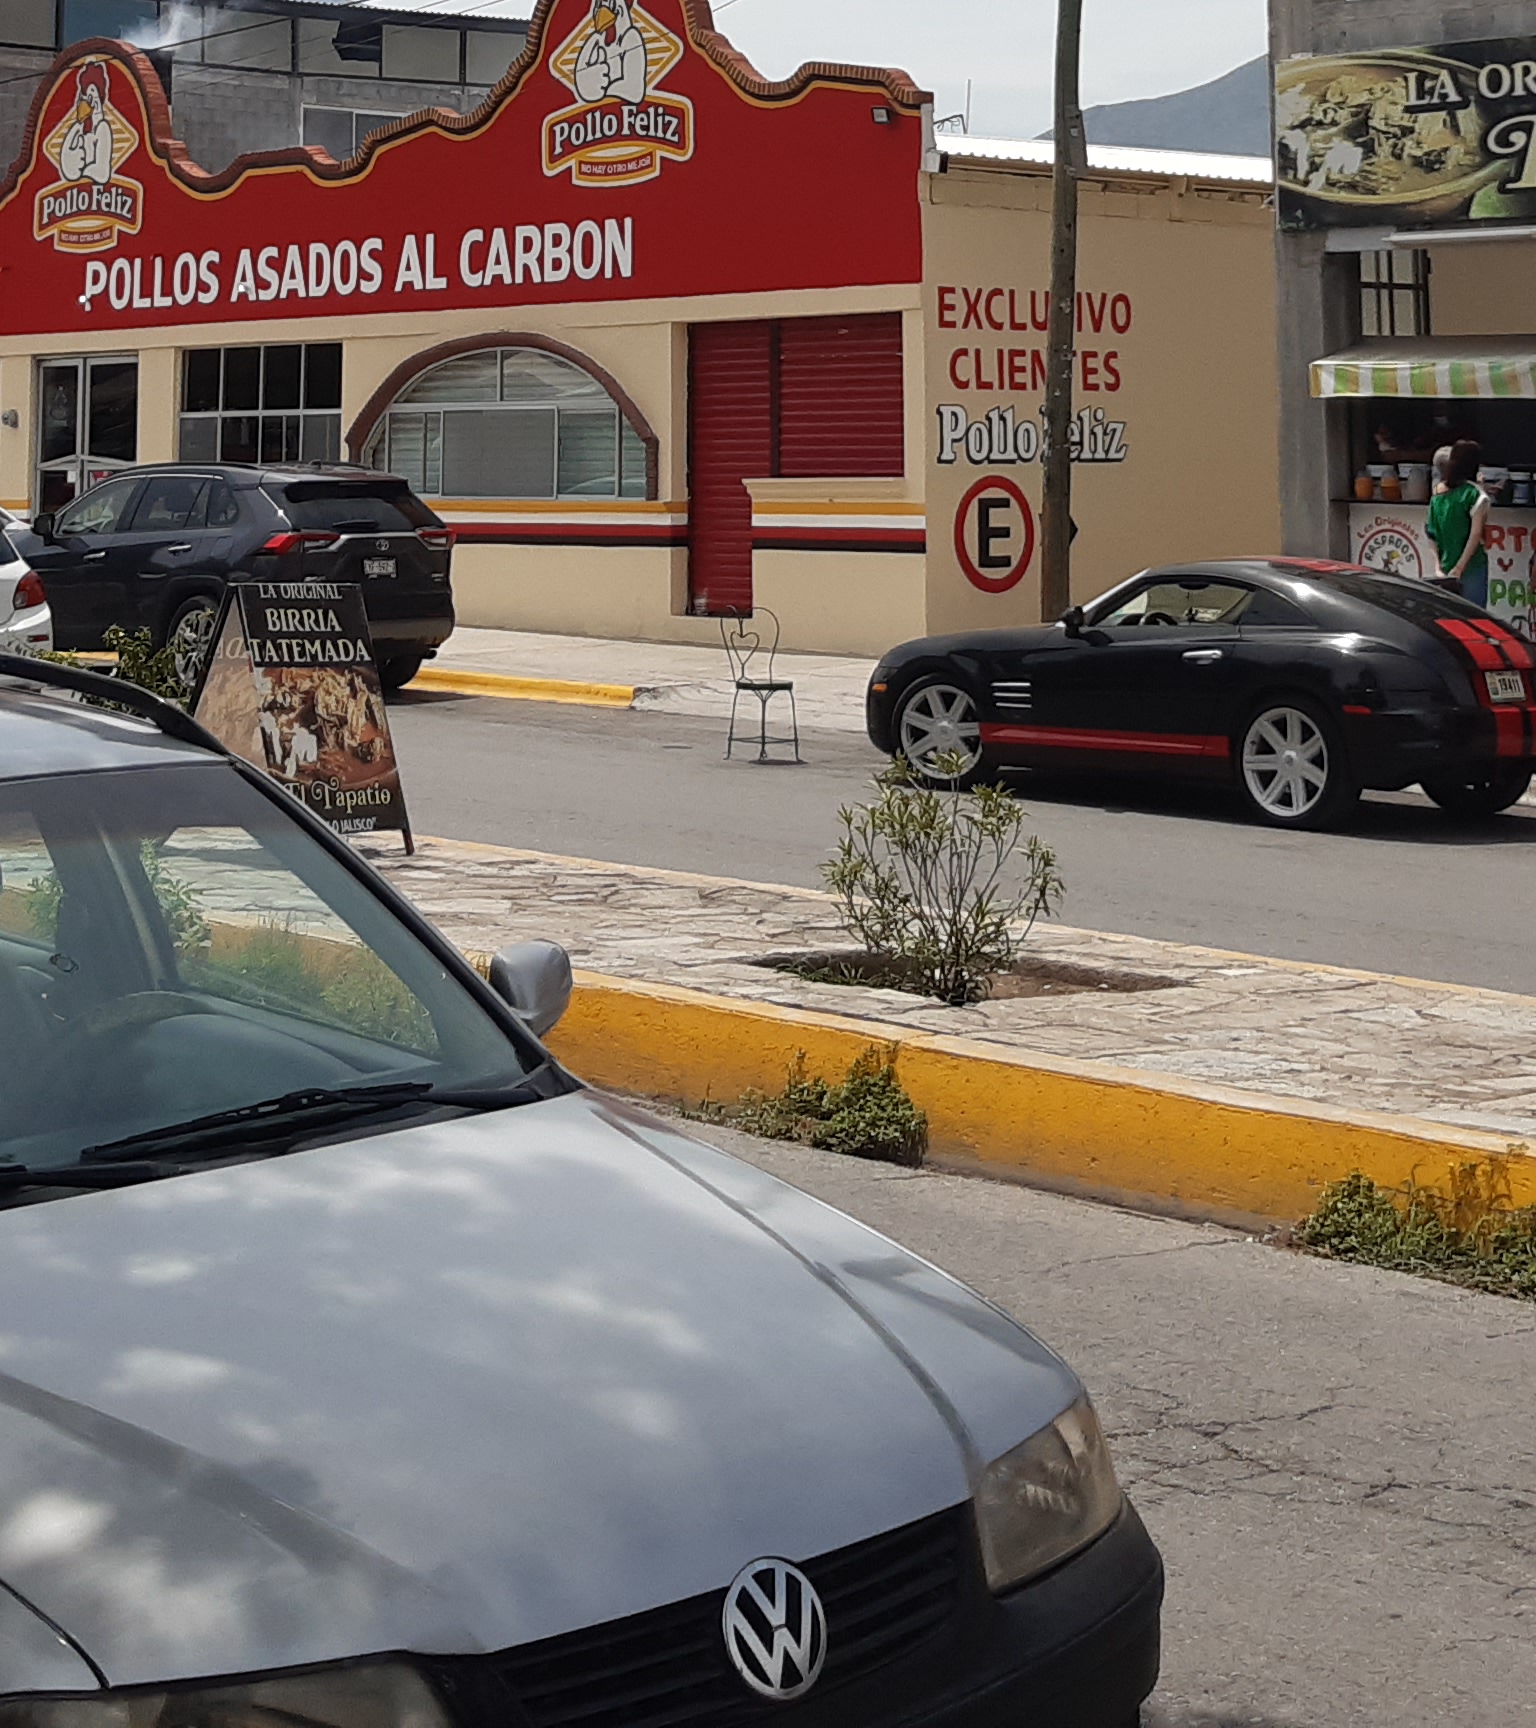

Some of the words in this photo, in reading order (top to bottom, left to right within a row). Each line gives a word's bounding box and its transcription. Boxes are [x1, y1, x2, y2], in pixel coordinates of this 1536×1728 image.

[1404, 71, 1462, 107] LA
[553, 109, 618, 156] Pollo
[620, 105, 679, 143] Feliz
[42, 187, 89, 225] Pollo
[91, 184, 134, 219] Feliz
[84, 250, 220, 312] POLLOS
[230, 237, 384, 302] ASADOS
[394, 233, 448, 292] AL
[459, 216, 633, 288] CARBON
[937, 286, 1132, 335] EXCLUIVO
[949, 347, 1121, 393] CLIENES
[937, 404, 1038, 464] Pollo
[977, 497, 1012, 569] E
[1364, 534, 1415, 562] RASPADOS
[260, 584, 277, 599] LA
[280, 584, 343, 600] ORIGINAL
[265, 608, 343, 633] BIRRIA
[251, 638, 372, 663] TATEMADA
